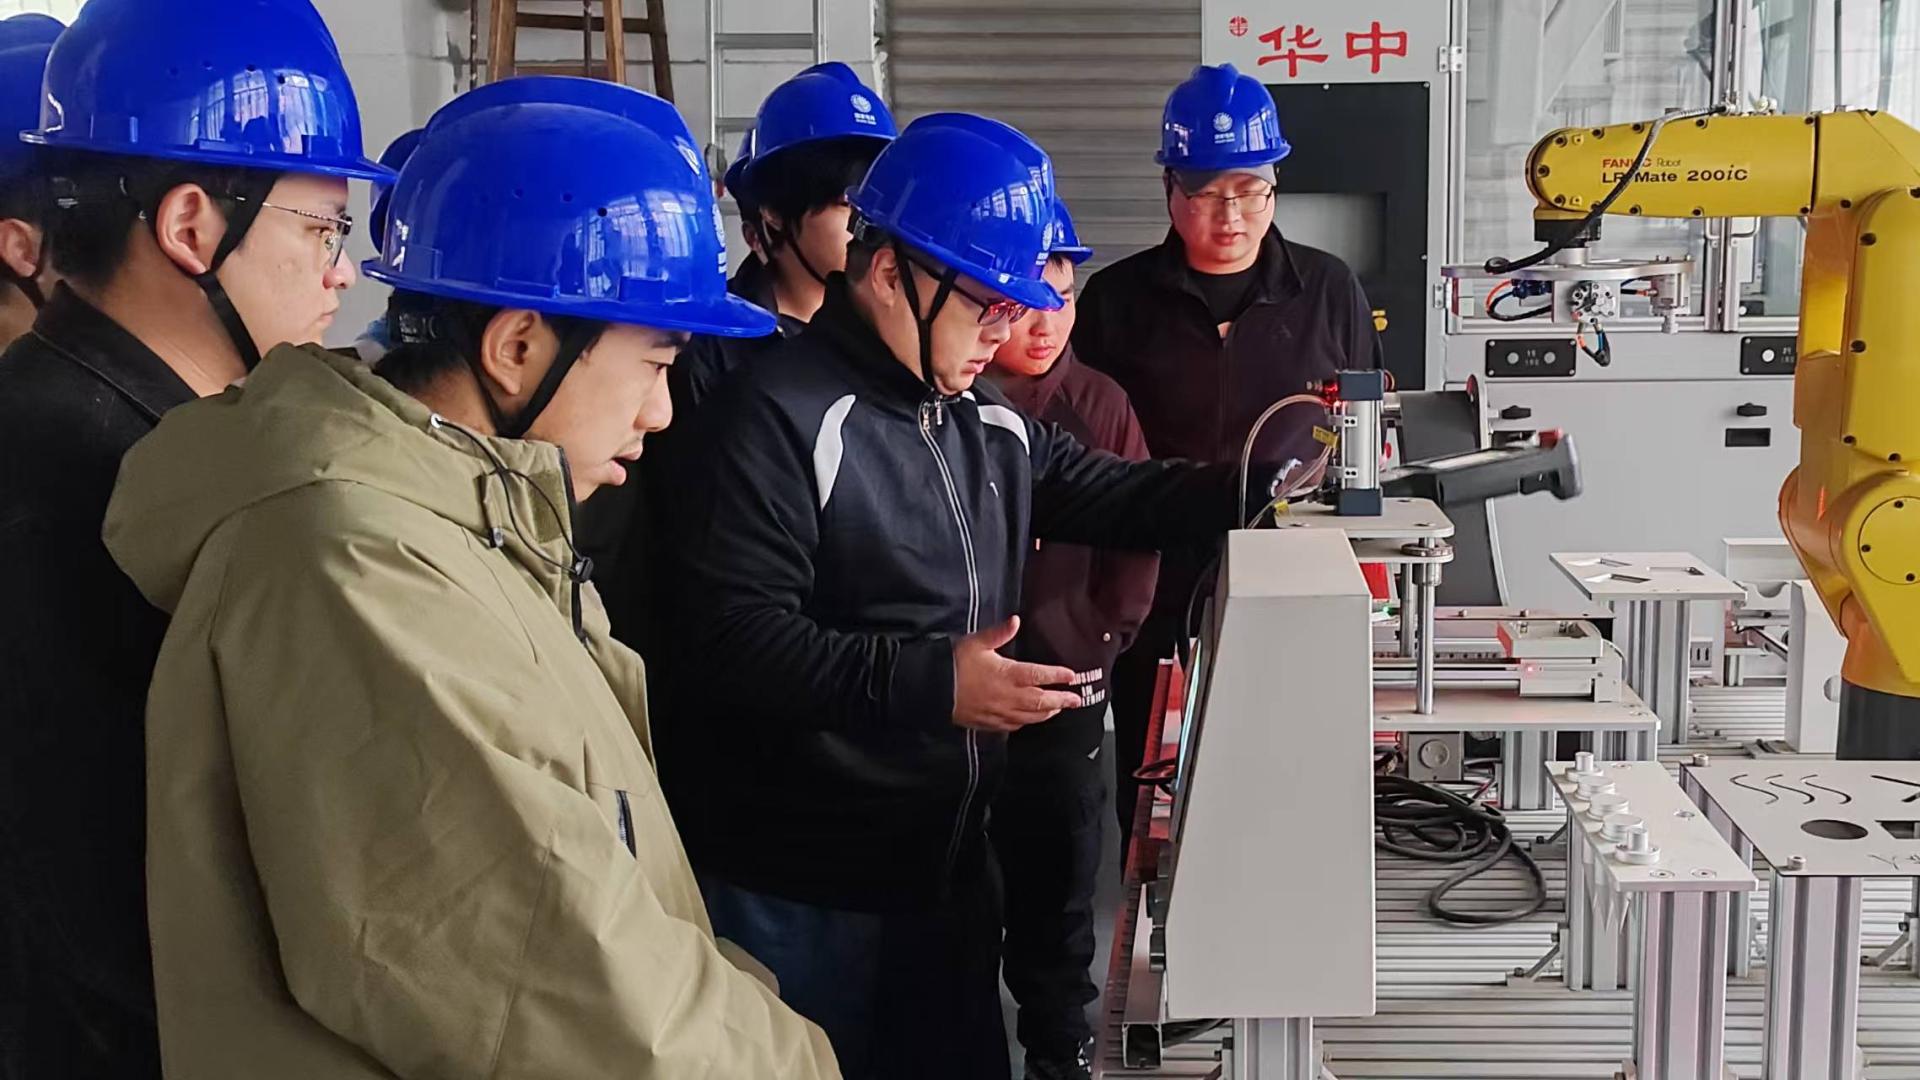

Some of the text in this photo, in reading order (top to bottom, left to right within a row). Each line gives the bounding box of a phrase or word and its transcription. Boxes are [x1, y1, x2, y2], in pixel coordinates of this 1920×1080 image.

[1257, 21, 1407, 78] 华中
[1602, 158, 1682, 169] FANC Robot
[1634, 171, 1678, 183] Mate
[1687, 164, 1748, 182] 200iC
